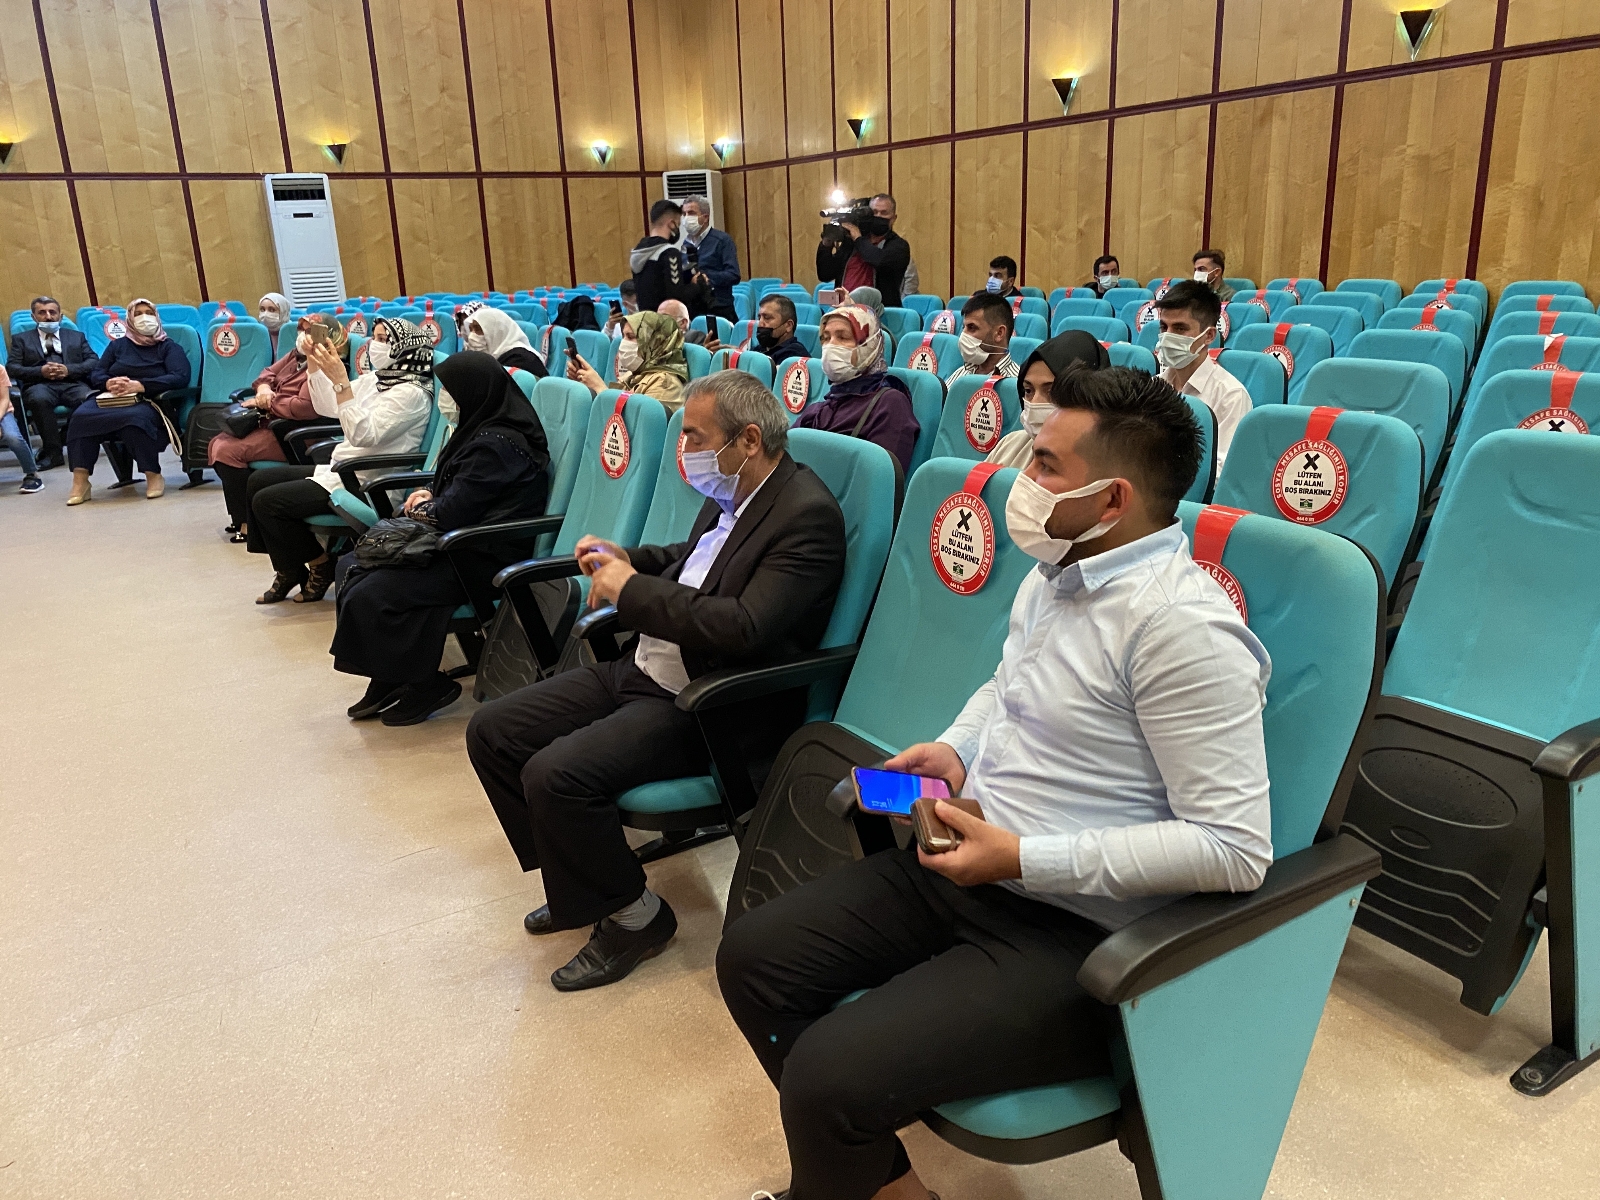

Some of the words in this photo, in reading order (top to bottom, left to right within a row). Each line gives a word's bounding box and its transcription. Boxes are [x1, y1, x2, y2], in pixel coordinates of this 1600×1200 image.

[1274, 468, 1284, 499] SOSYAL
[1281, 443, 1307, 466] MESAFE
[1308, 441, 1343, 475] SAĞLIĞINIZI
[1332, 475, 1345, 505] KORUR
[1297, 471, 1322, 479] LÜTFEN
[1298, 488, 1332, 496] BIRAKINIZ
[933, 521, 941, 557] SOSYAL
[939, 496, 962, 520] MESAFE
[979, 543, 992, 577] KORUR
[952, 529, 973, 543] LÜTFEN
[948, 538, 956, 547] BU
[957, 542, 974, 553] ALANI
[941, 545, 952, 555] BOŞ
[952, 549, 980, 566] BIRAKINIZ
